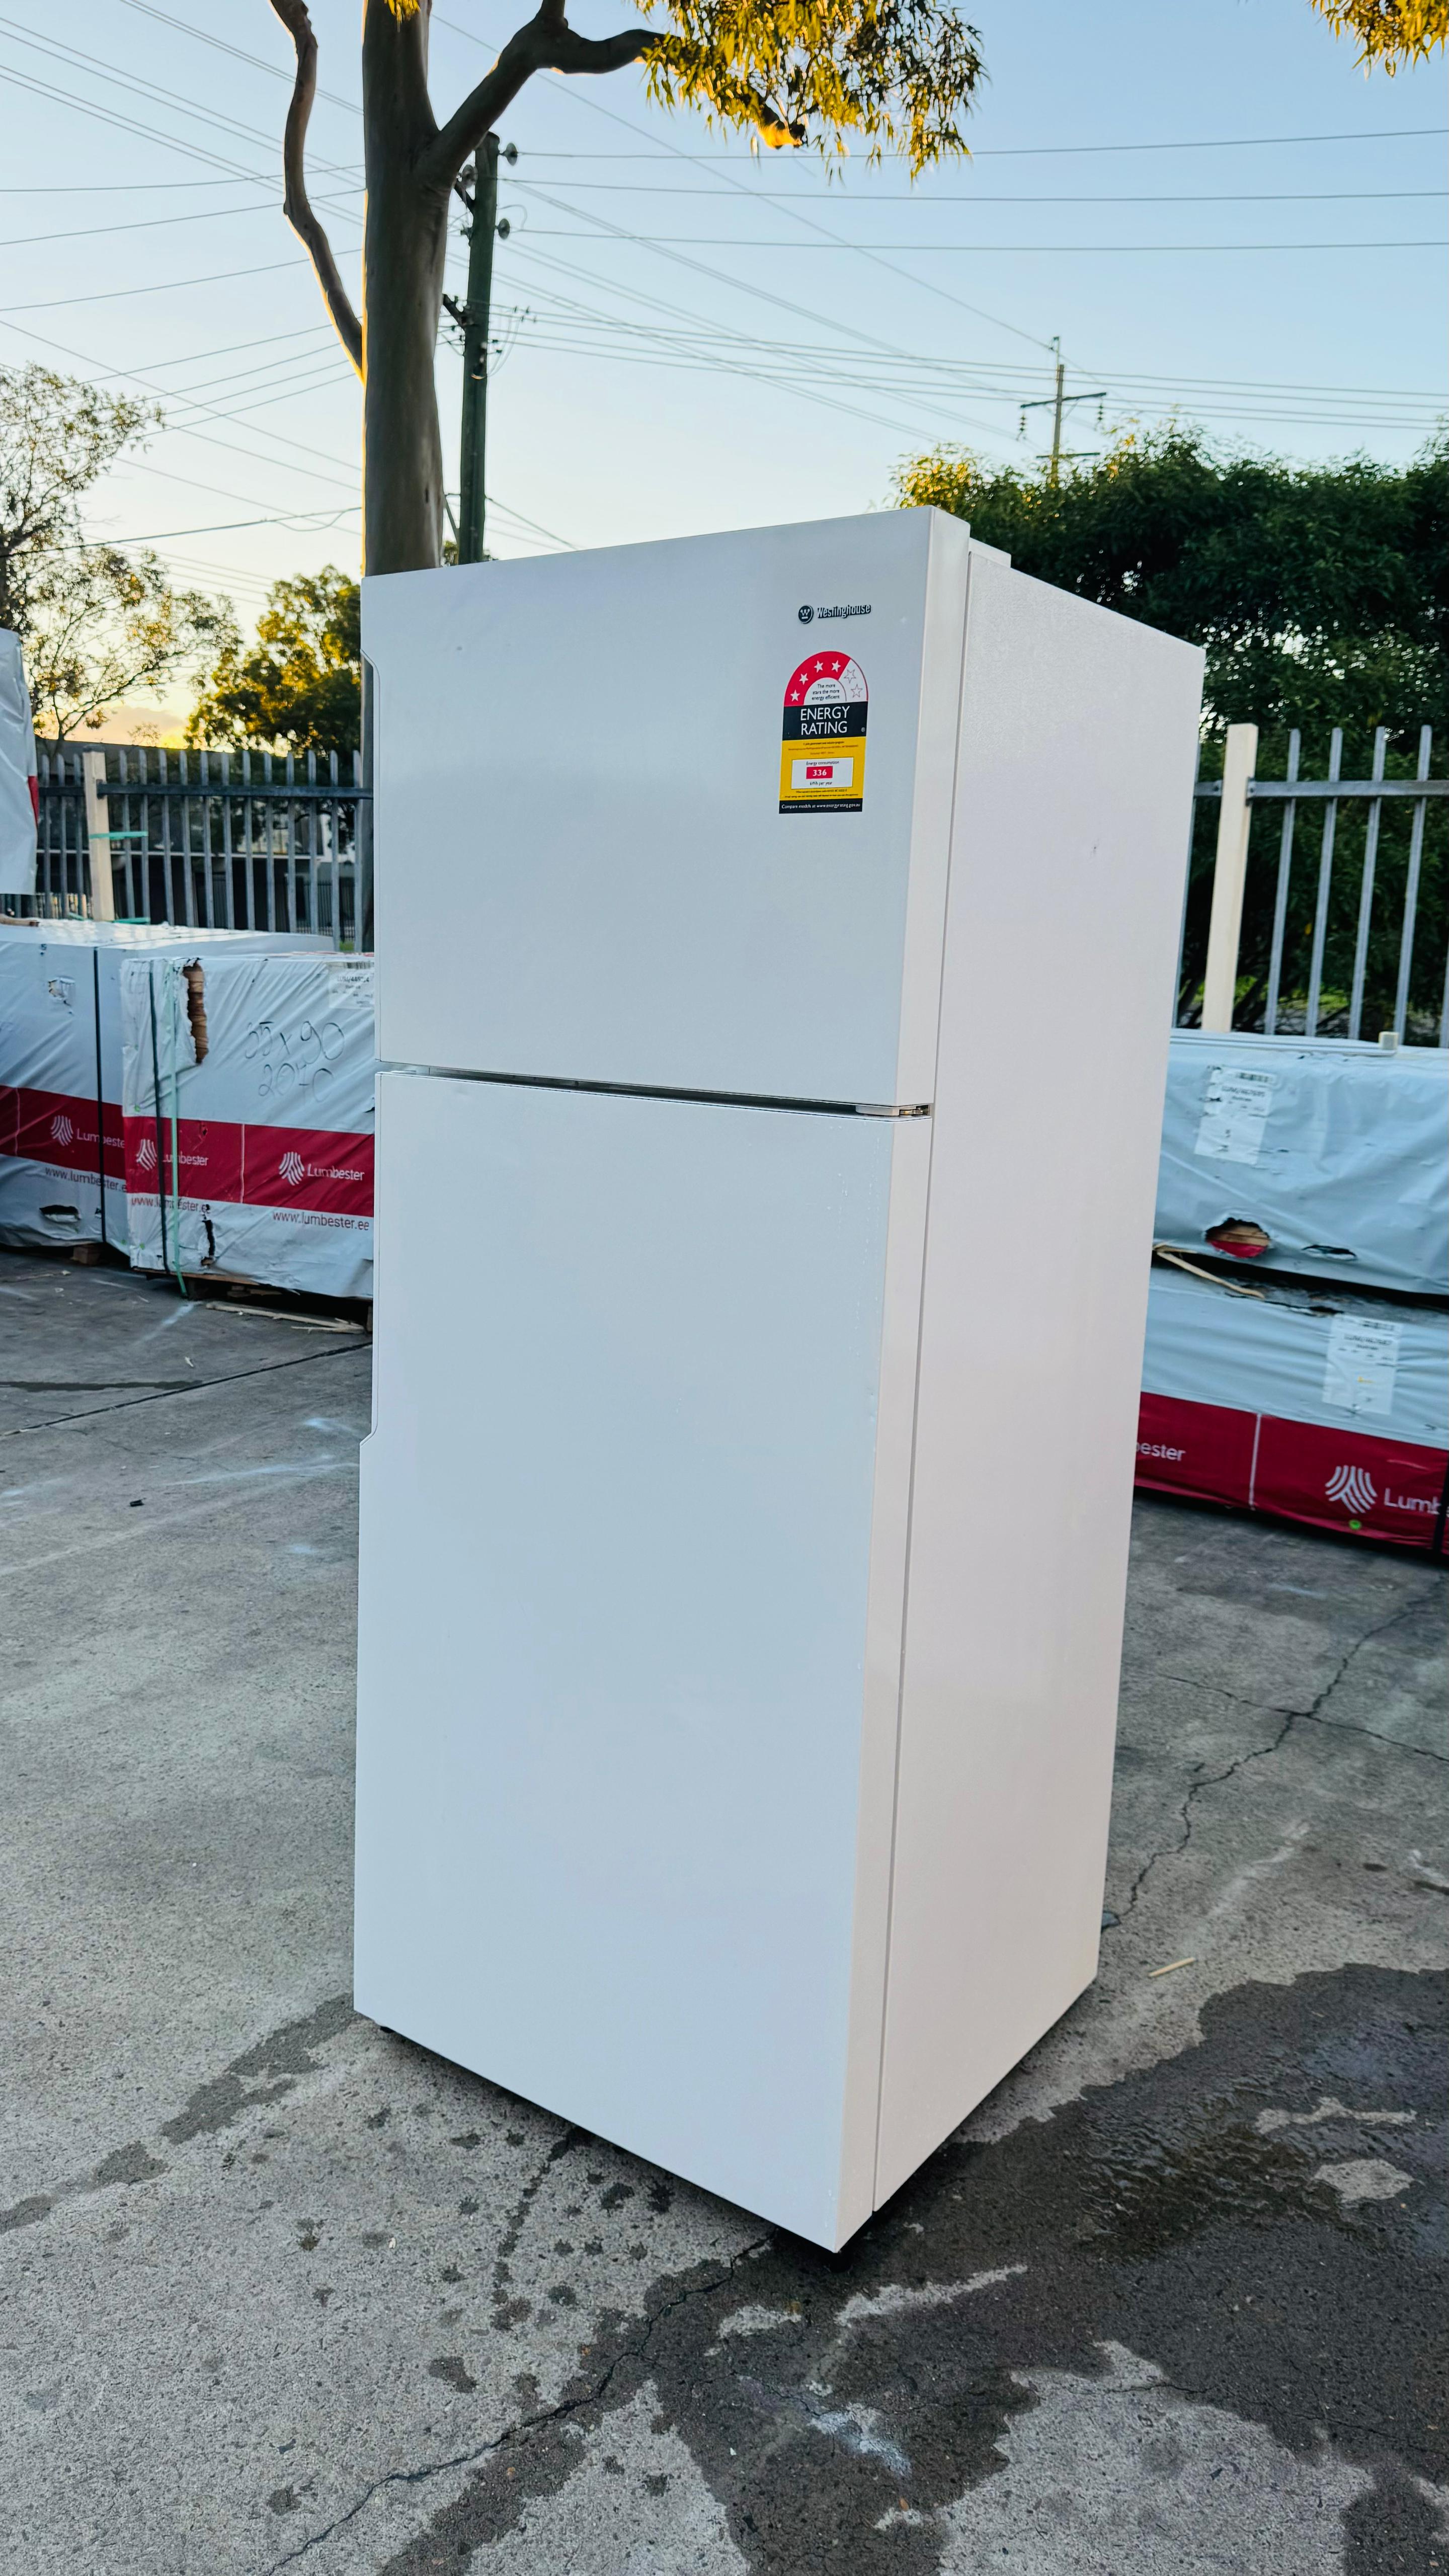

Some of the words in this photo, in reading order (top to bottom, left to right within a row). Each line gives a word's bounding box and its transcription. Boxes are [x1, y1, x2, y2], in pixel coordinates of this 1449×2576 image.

[818, 605, 871, 618] Westinghouse
[800, 706, 850, 720] ENERGY
[801, 721, 847, 735] RATING
[307, 1163, 365, 1181] Lumbester
[273, 1212, 369, 1231] www.lumbester.ee
